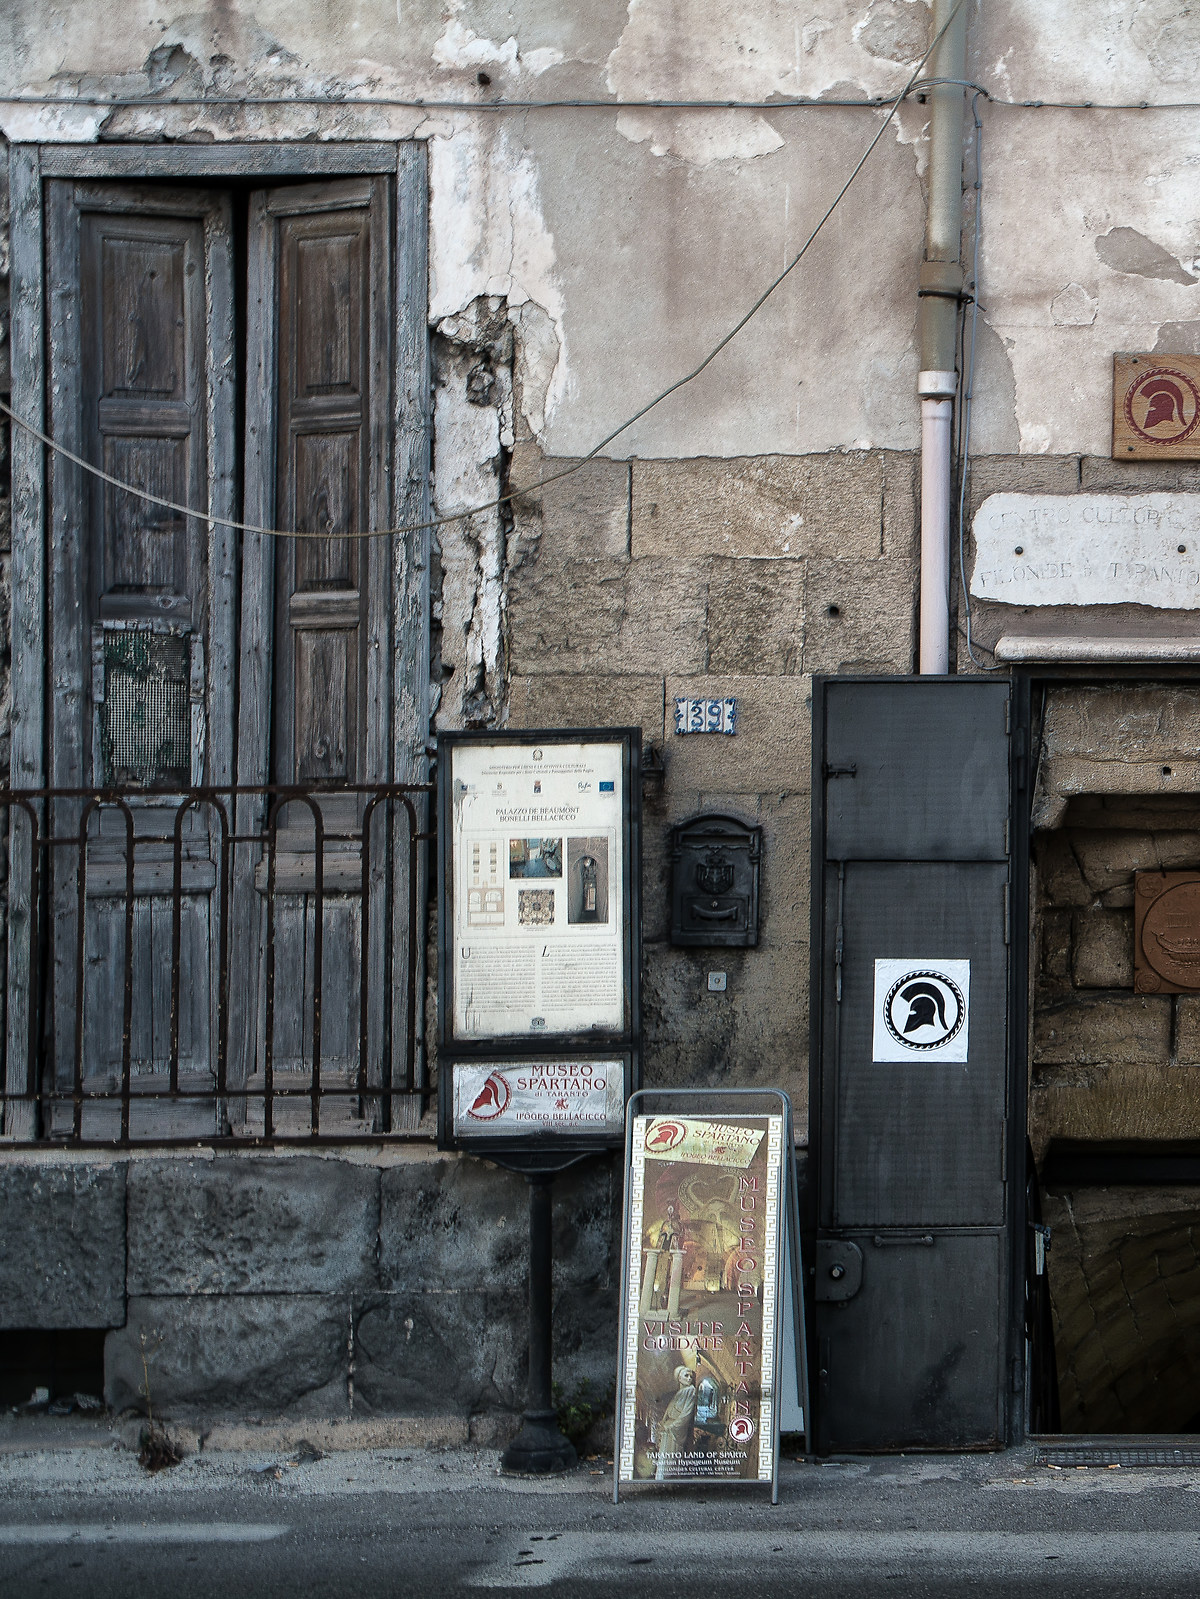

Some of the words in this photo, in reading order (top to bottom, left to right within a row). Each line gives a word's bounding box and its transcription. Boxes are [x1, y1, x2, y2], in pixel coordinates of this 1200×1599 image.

[691, 704, 721, 727] 39
[540, 807, 580, 815] BEAUMONT
[531, 1065, 593, 1077] MUSEO
[516, 1078, 606, 1091] SPARTANO
[708, 1123, 755, 1136] MUSEO
[693, 1130, 760, 1145] SPARTANO
[736, 1176, 759, 1272] MUSEO
[644, 1321, 724, 1336] VISITE
[643, 1337, 723, 1351] GUIDATE
